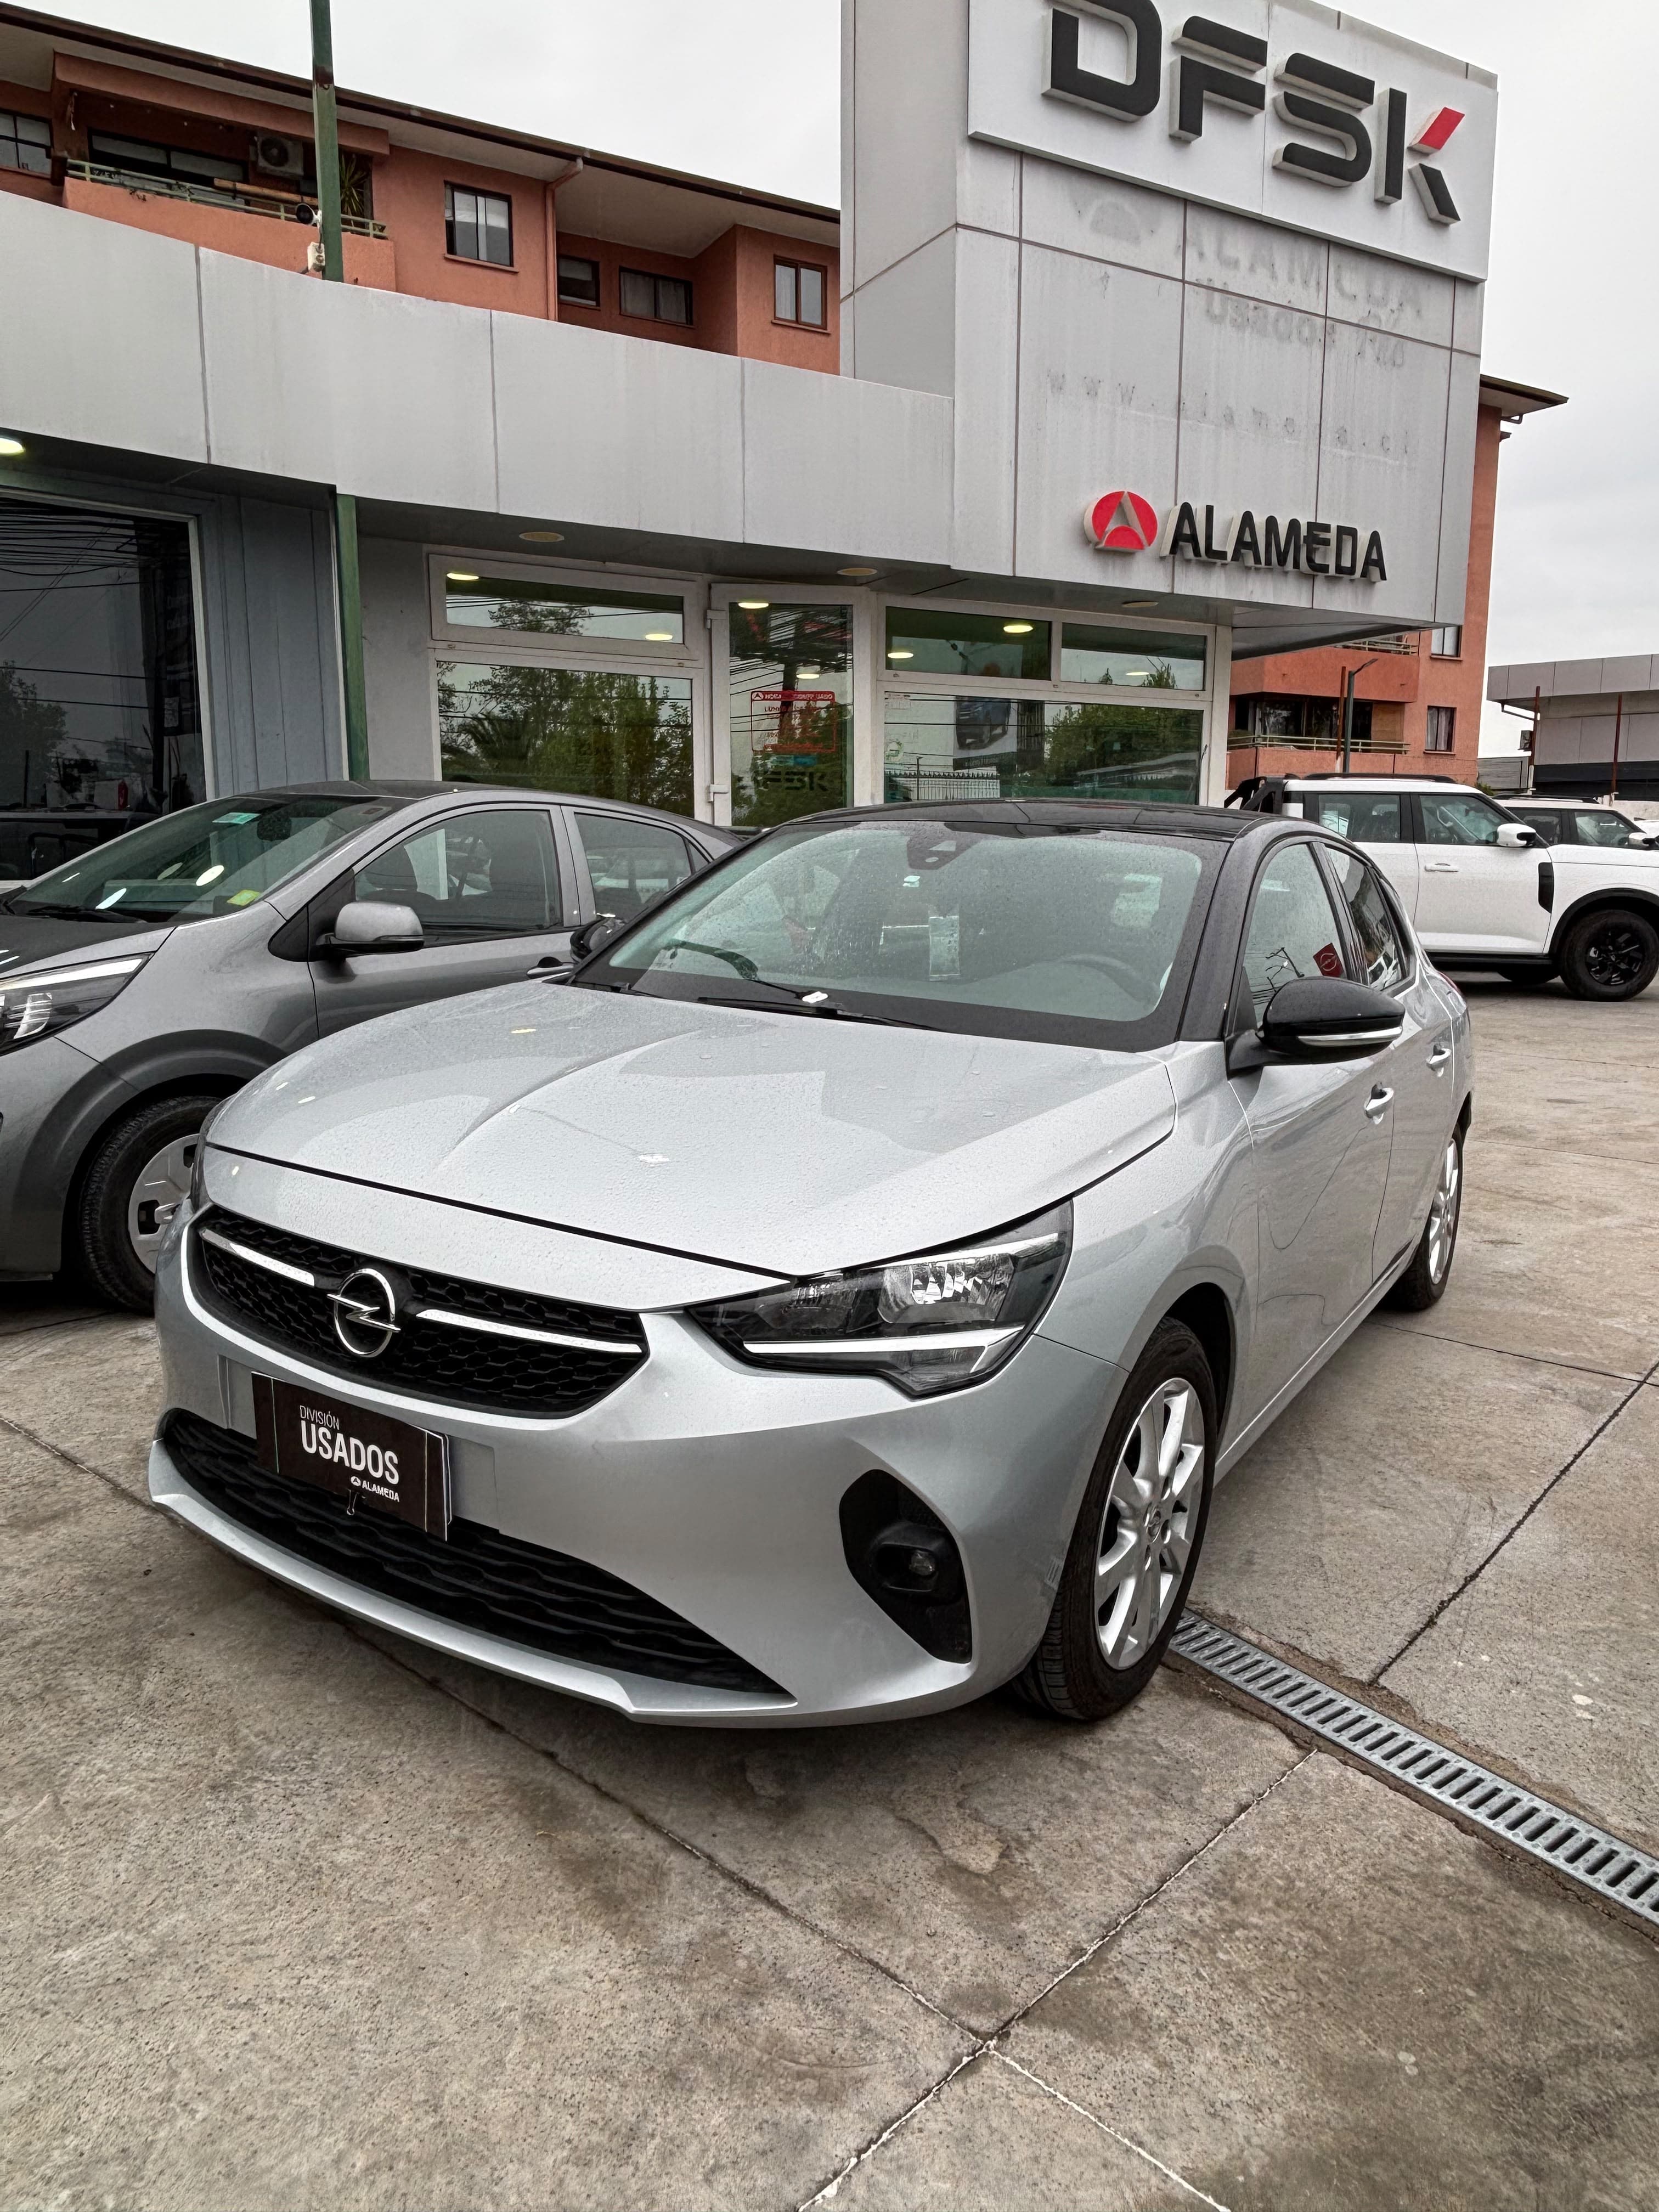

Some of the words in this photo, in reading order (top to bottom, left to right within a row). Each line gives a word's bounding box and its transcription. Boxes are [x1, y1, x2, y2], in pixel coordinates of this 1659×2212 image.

[1042, 0, 1464, 224] DFSK
[1161, 501, 1387, 583] ALAMEDA
[300, 1405, 339, 1430] DIVISIÓN
[301, 1420, 399, 1485] USADOS
[362, 1480, 399, 1503] ALAMEDA
